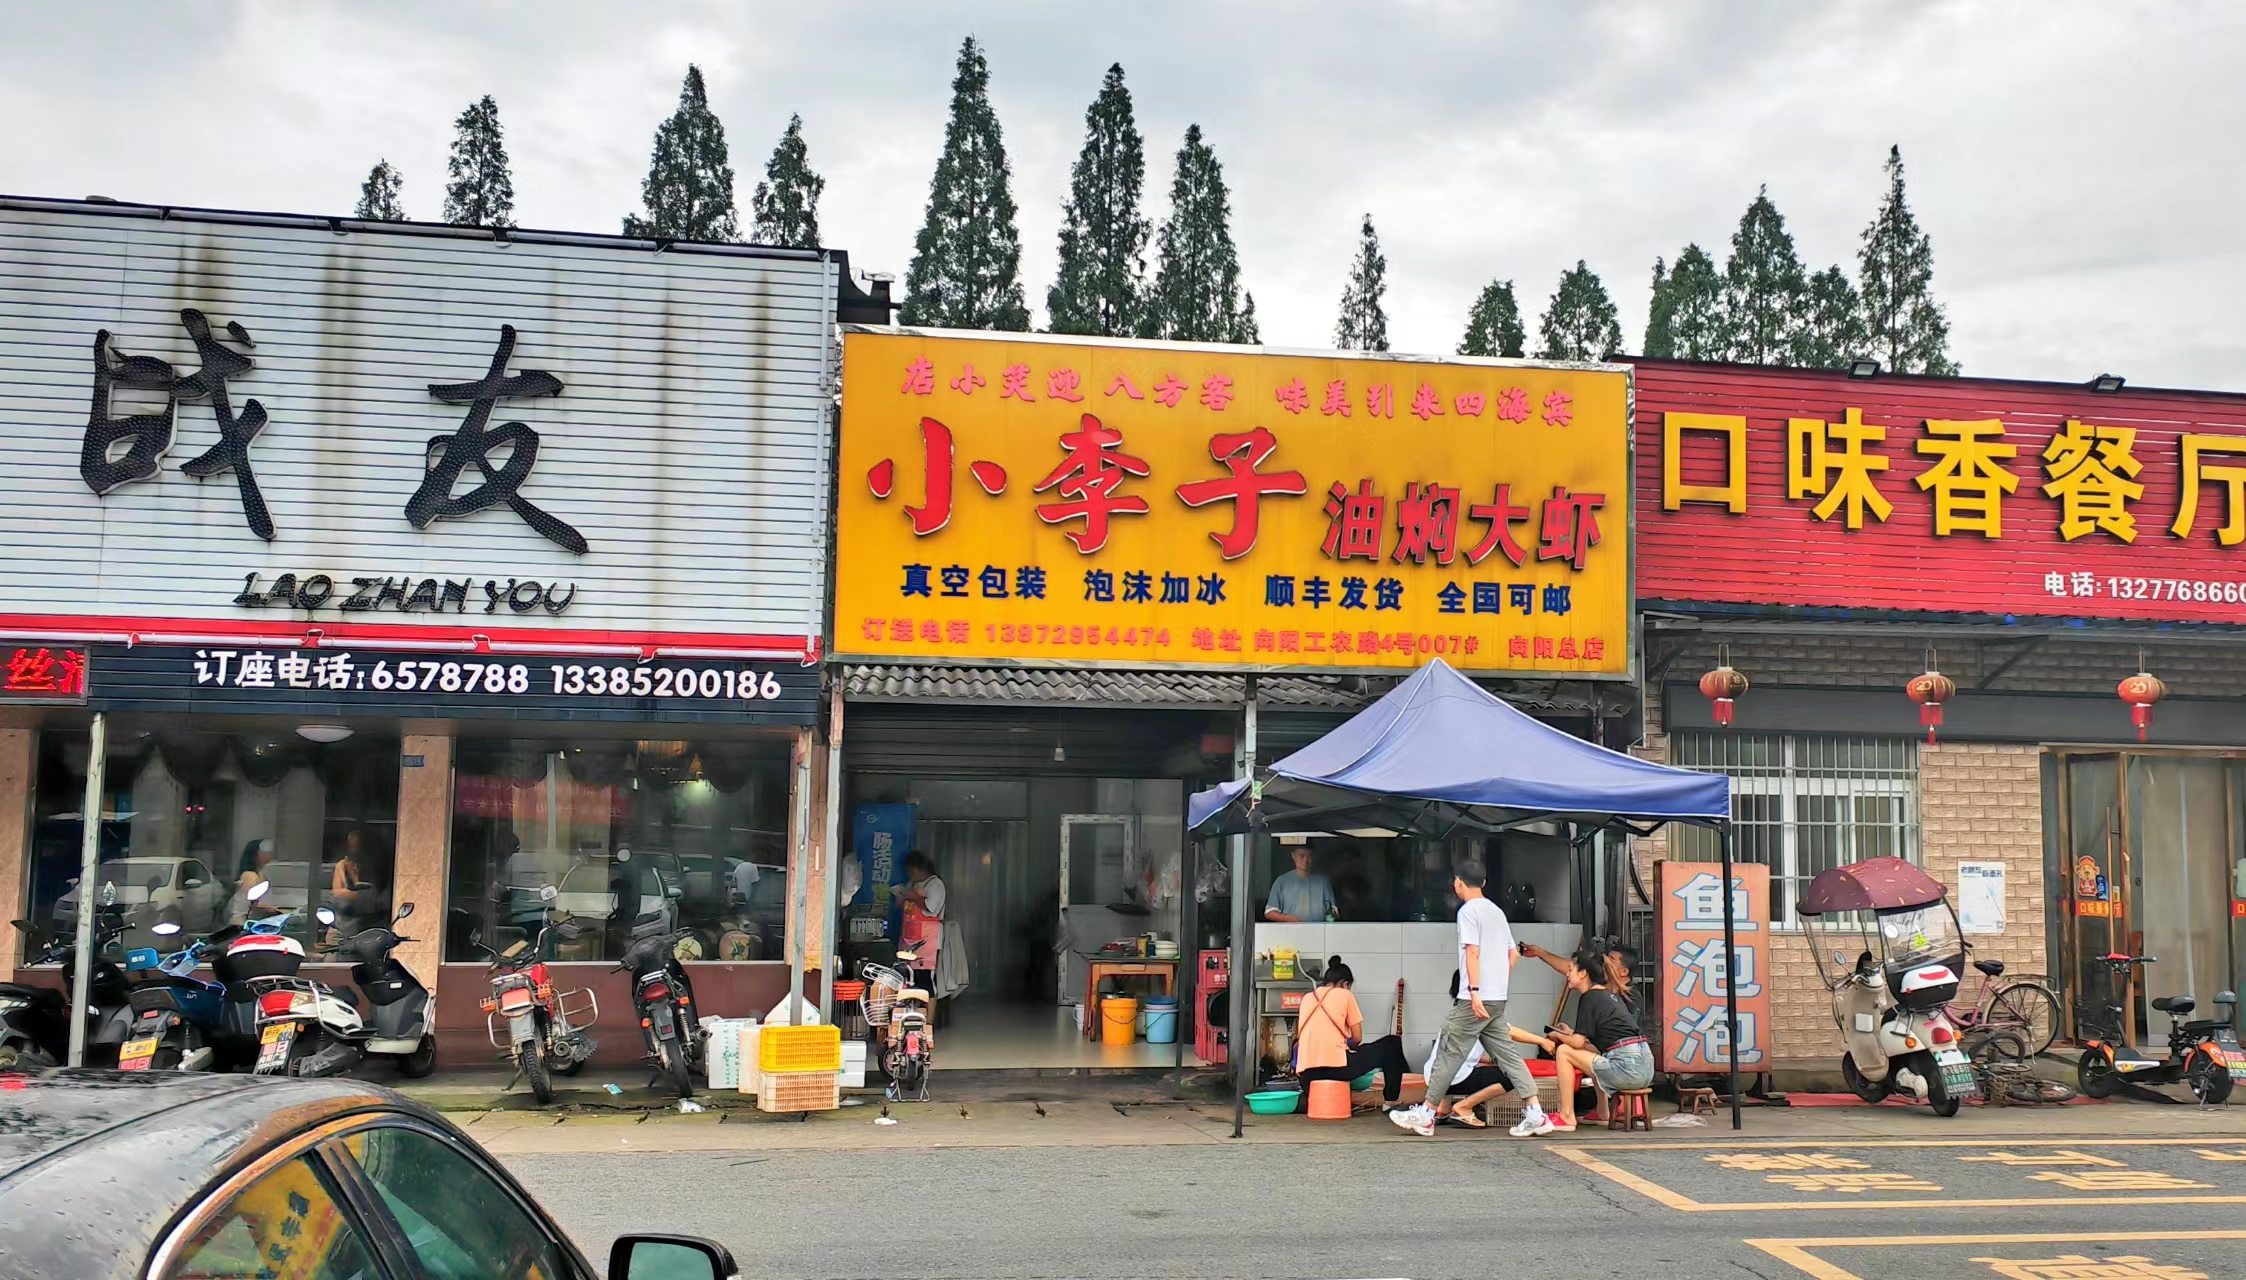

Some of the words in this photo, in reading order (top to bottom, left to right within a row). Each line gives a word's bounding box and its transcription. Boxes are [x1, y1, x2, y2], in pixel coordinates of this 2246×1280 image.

[901, 356, 1235, 411] 店小笑迎八方客
[1275, 377, 1575, 428] 味美引来四海宾
[866, 412, 1310, 563] 小李子
[1321, 478, 1608, 571] 油焖大虾
[1660, 407, 2246, 546] 口味香餐厅
[233, 571, 336, 612] LAO
[338, 575, 474, 615] ZHAN
[482, 577, 579, 616] YOU
[902, 564, 1047, 600] 真空包装
[1084, 570, 1228, 605] 泡沫加冰
[1265, 576, 1405, 610] 顺丰发货
[1438, 582, 1573, 616] 全国可邮
[861, 617, 970, 645] 订送电话
[986, 623, 1172, 648] 13872954474
[1192, 627, 1242, 652] 地址
[1253, 630, 1479, 656] 向阳工农路4号007#
[1508, 635, 1605, 660] 向阳总店
[552, 664, 783, 702] 13385200186
[1672, 872, 1764, 1065] 鱼泡泡
